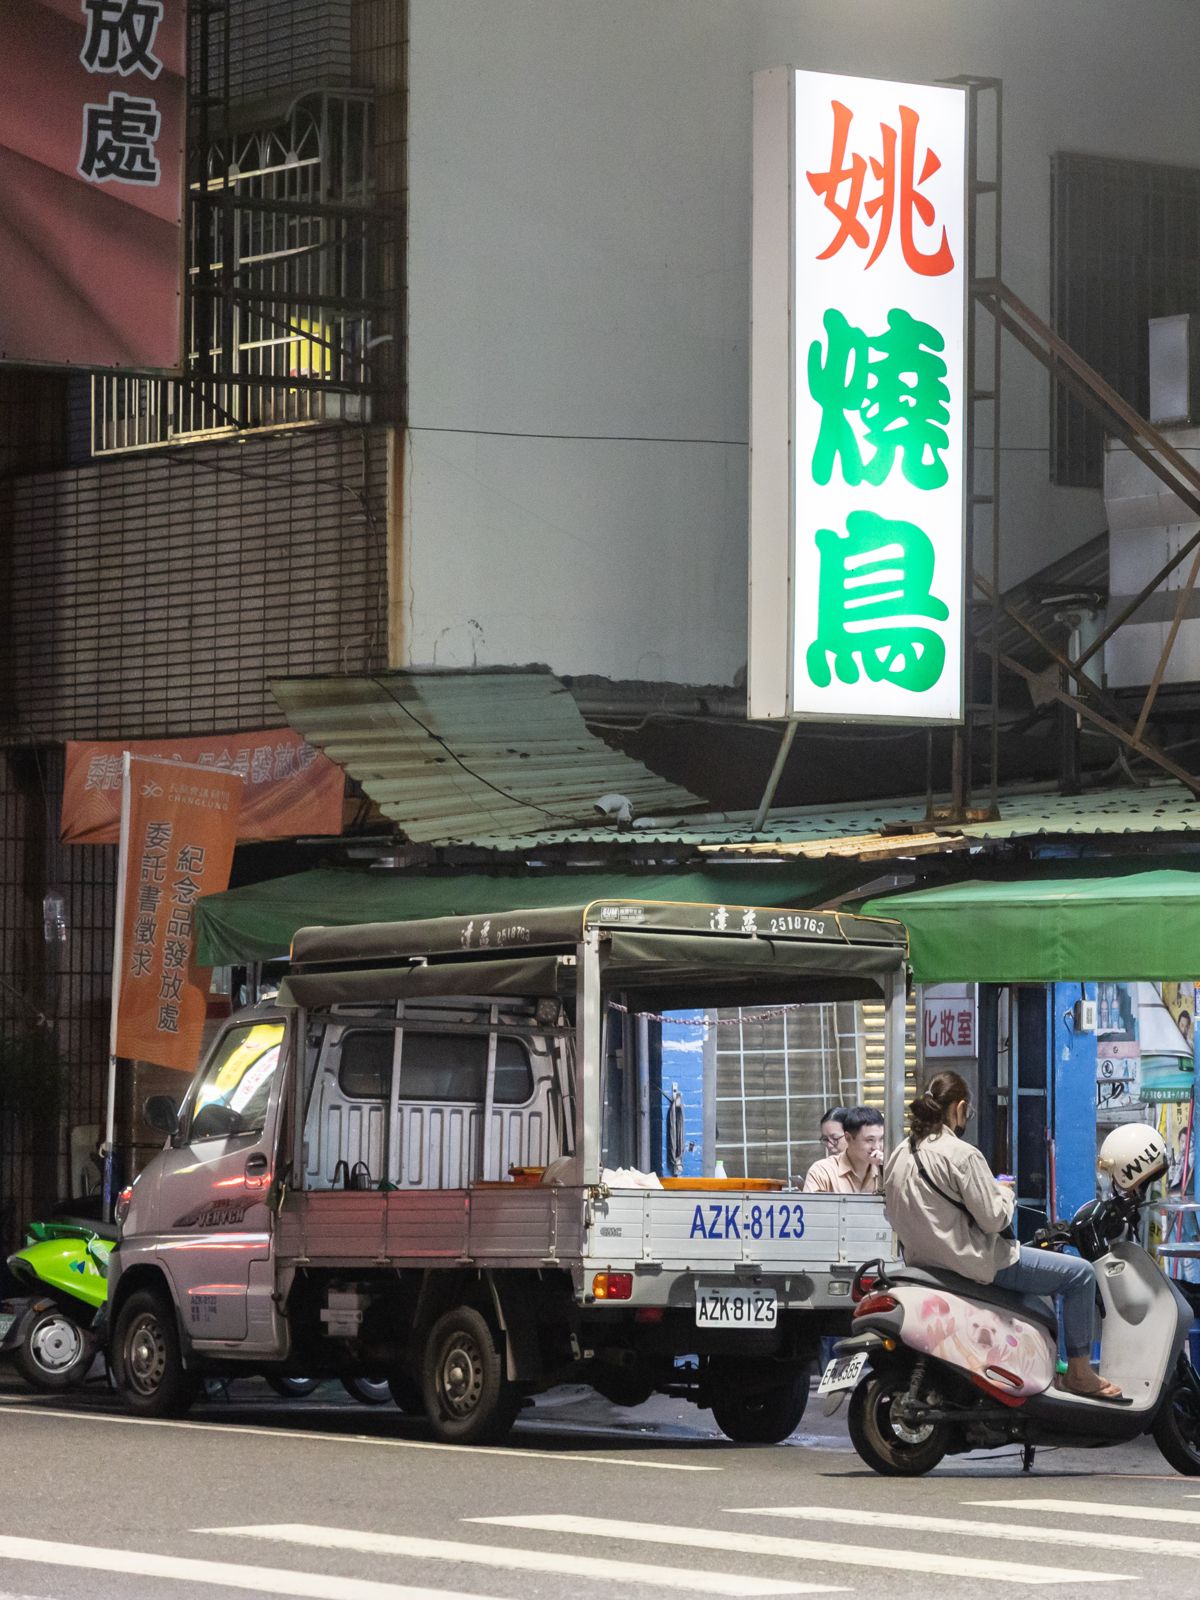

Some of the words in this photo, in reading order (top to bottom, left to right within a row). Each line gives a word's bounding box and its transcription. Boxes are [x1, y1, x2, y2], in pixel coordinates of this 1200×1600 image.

[77, 0, 163, 187] 放處
[806, 99, 955, 692] 姚燒鳥
[130, 821, 173, 978] 委託書徵求
[156, 844, 206, 1034] 紀念品發放處
[770, 916, 825, 935] 2518763
[690, 1204, 805, 1240] AZK-8123
